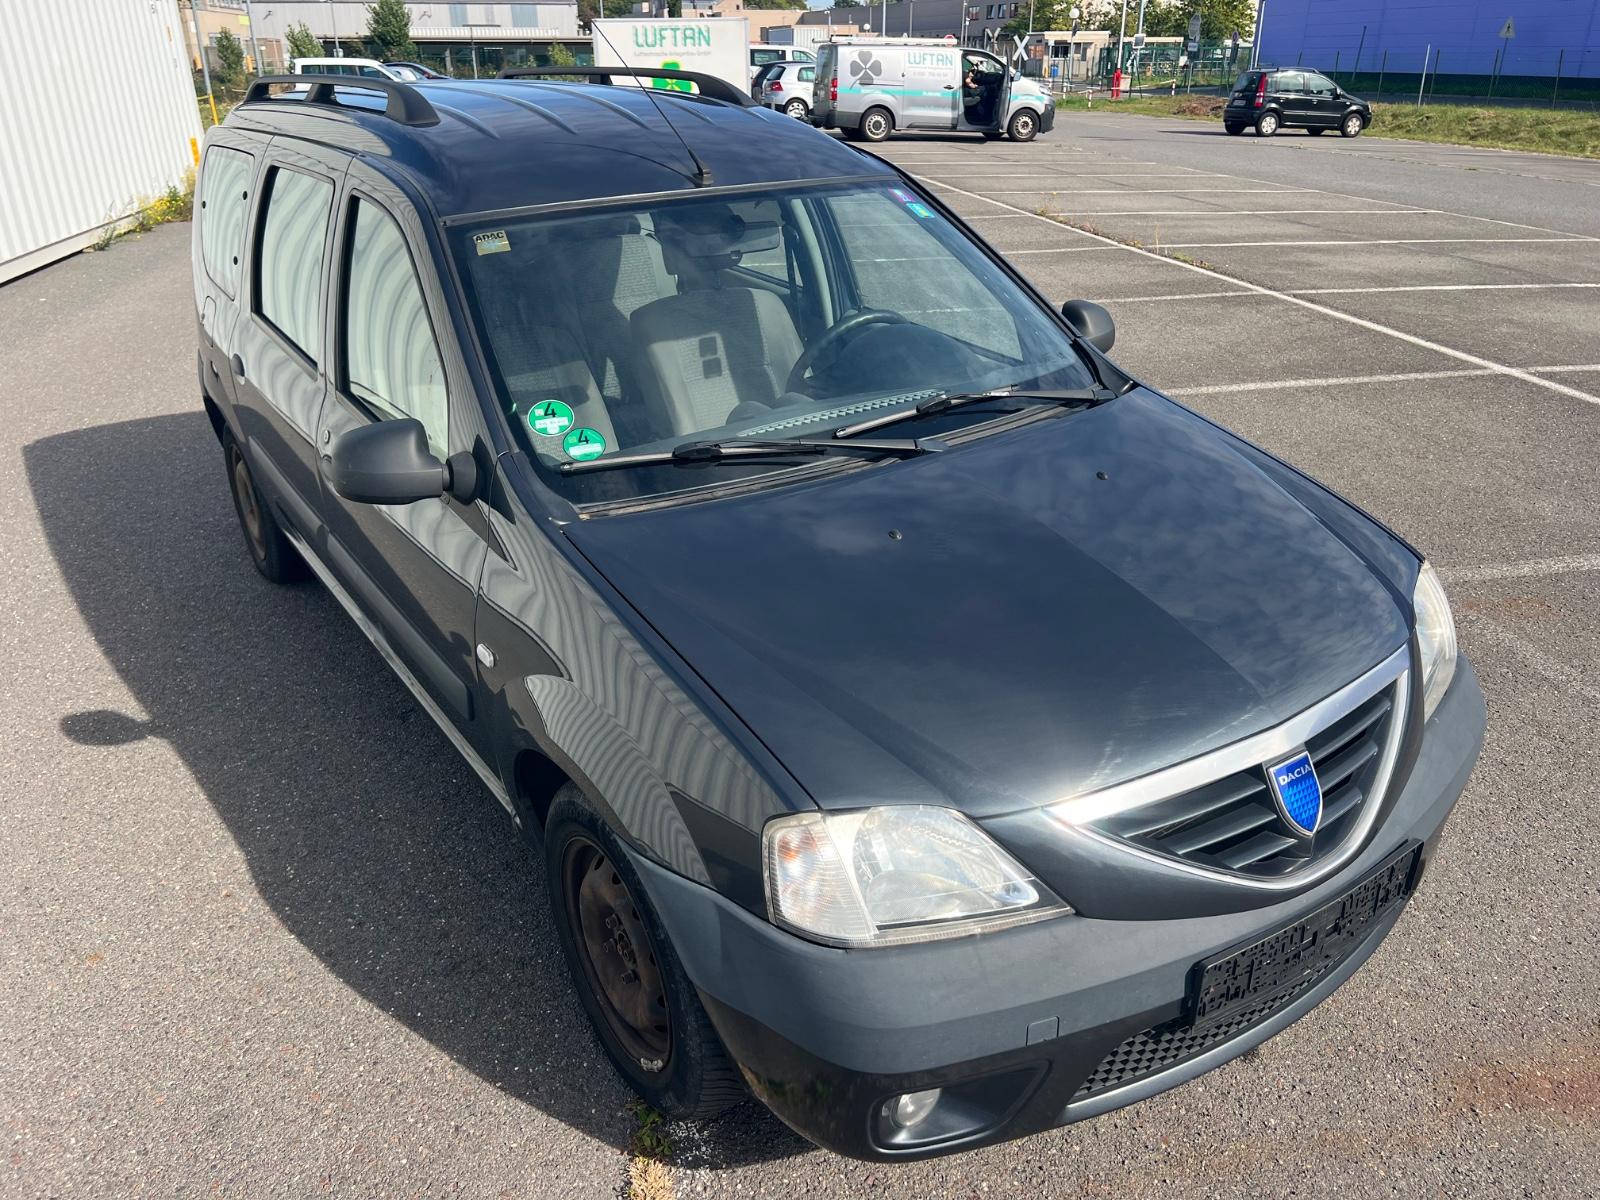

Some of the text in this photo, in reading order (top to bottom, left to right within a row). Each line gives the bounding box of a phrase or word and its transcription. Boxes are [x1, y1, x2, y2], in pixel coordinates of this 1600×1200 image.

[632, 25, 711, 48] LUFTAN
[907, 51, 953, 66] LUFTAN
[475, 231, 505, 242] ADAC
[543, 402, 557, 417] 4
[578, 429, 590, 444] 4
[1279, 764, 1312, 786] DACIA
